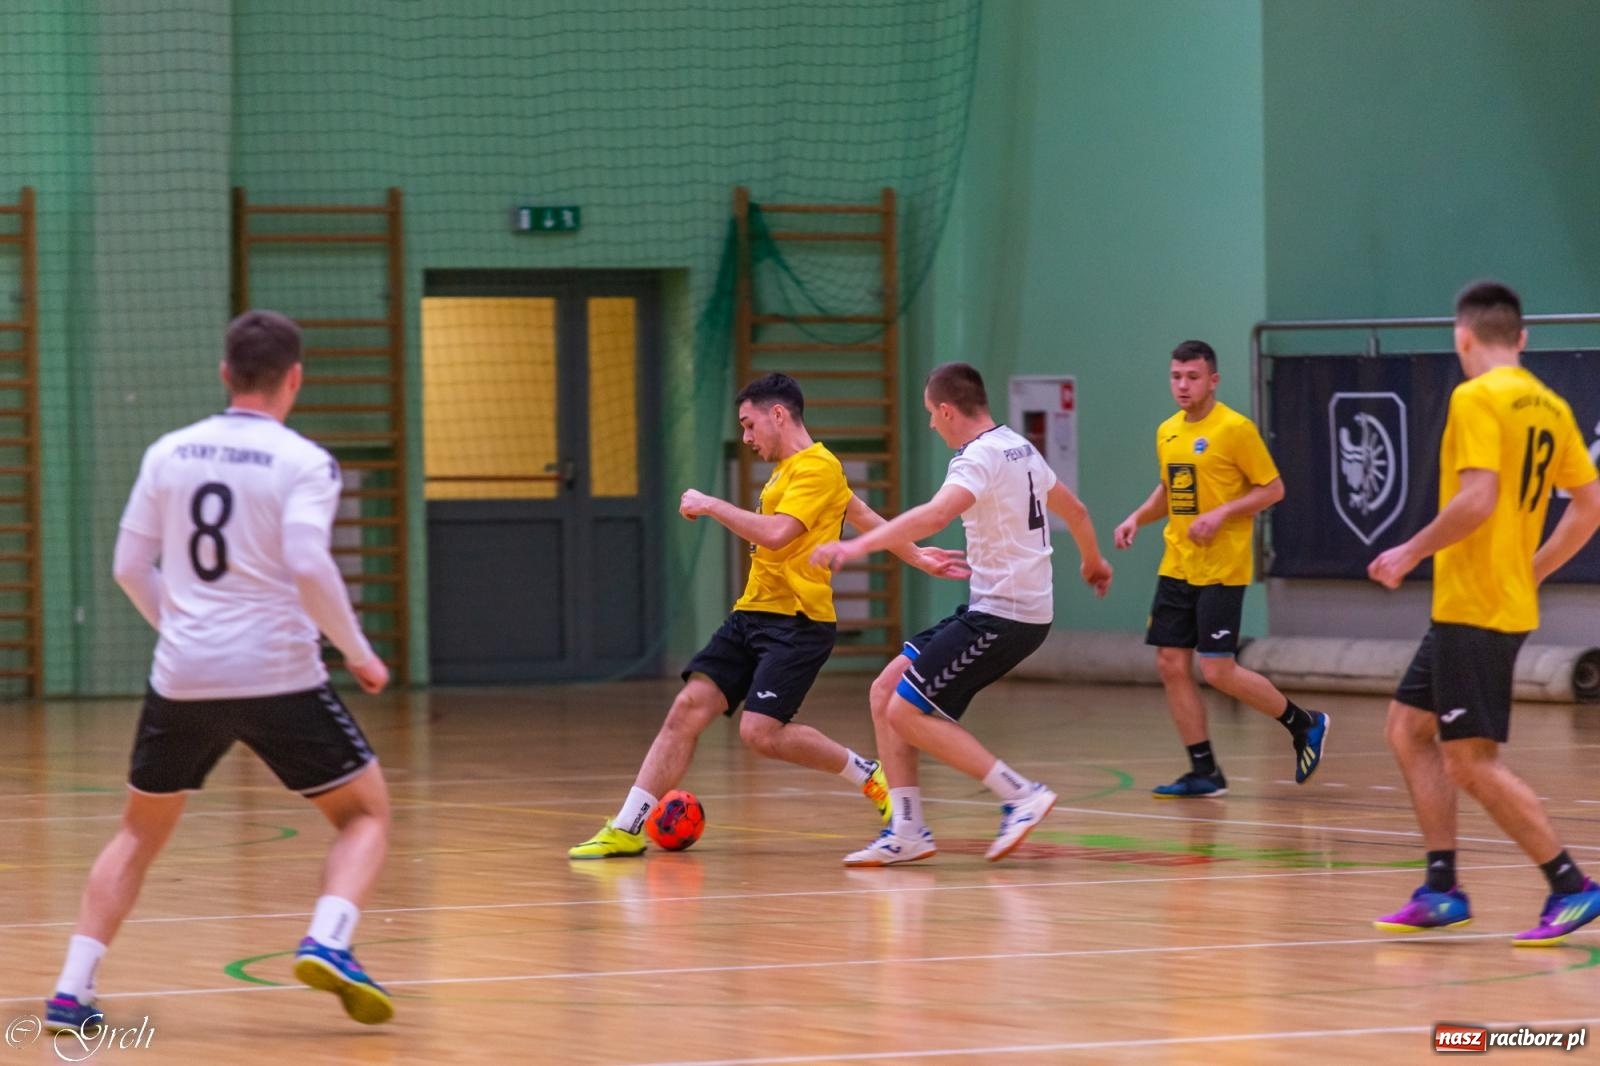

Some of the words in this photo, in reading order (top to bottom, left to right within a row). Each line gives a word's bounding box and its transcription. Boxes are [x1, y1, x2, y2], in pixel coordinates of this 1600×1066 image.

[1027, 471, 1047, 547] 4
[1518, 426, 1555, 513] 13
[190, 481, 233, 582] 8
